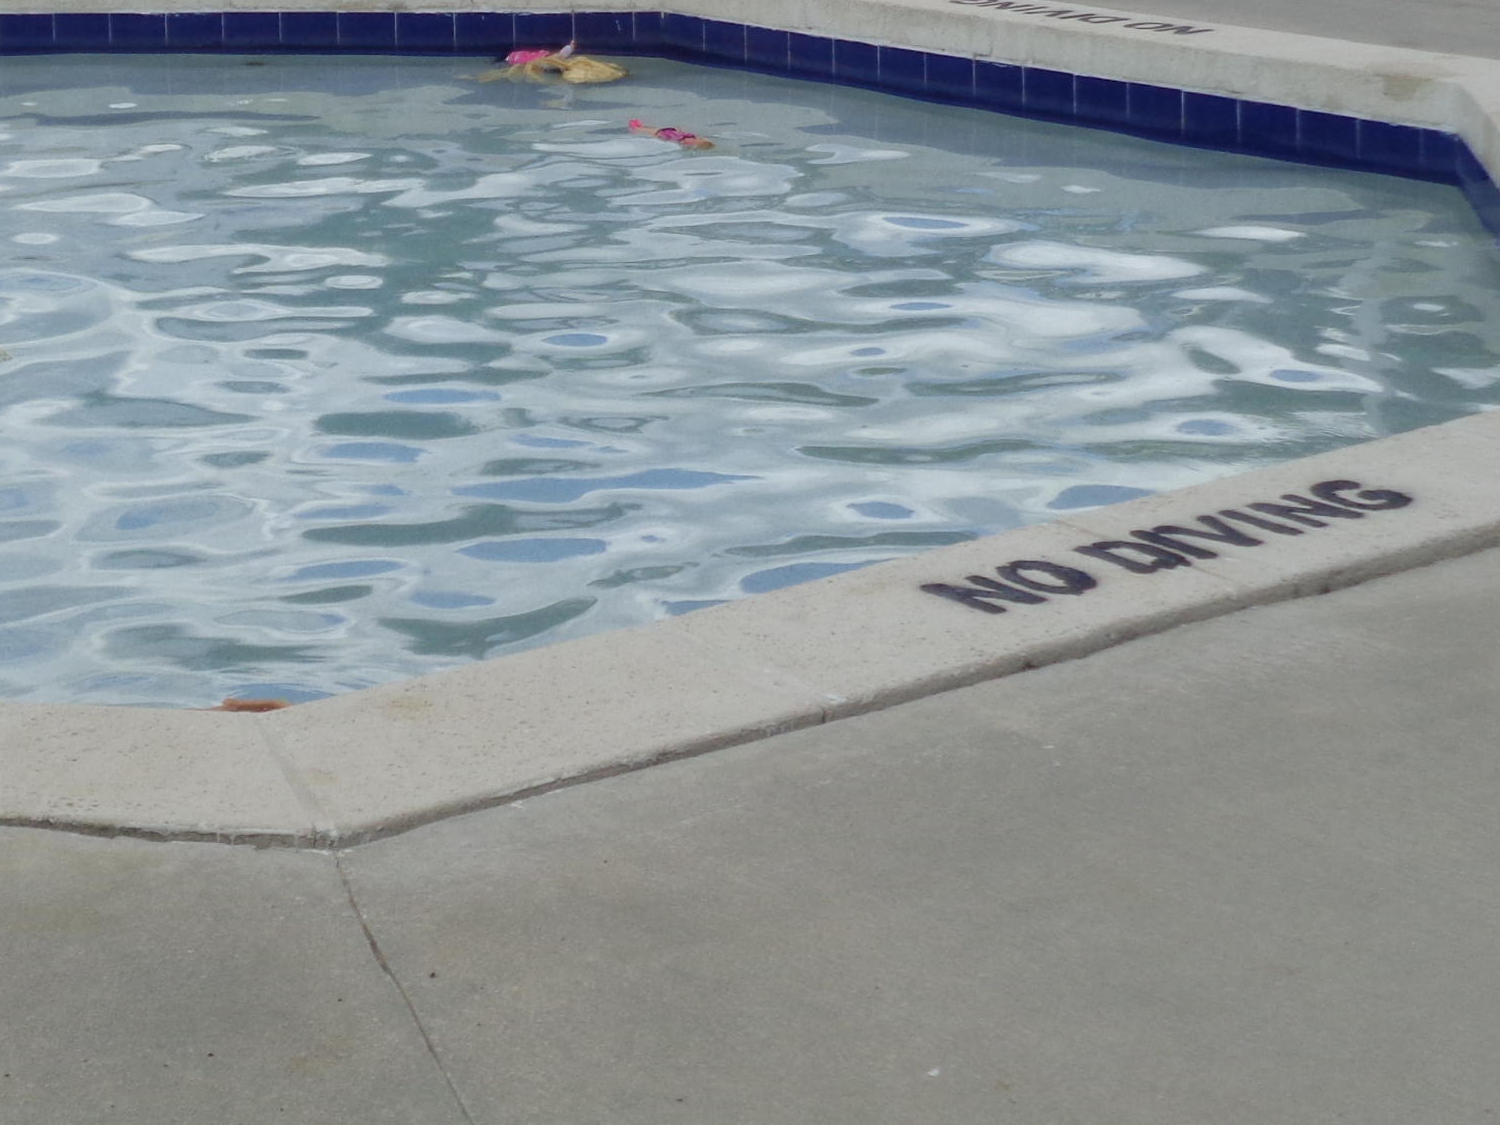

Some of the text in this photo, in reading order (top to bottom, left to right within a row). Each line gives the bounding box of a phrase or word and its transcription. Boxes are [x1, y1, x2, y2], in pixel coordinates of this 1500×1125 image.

[1124, 22, 1213, 35] NO
[919, 479, 1412, 614] NO DIVING
